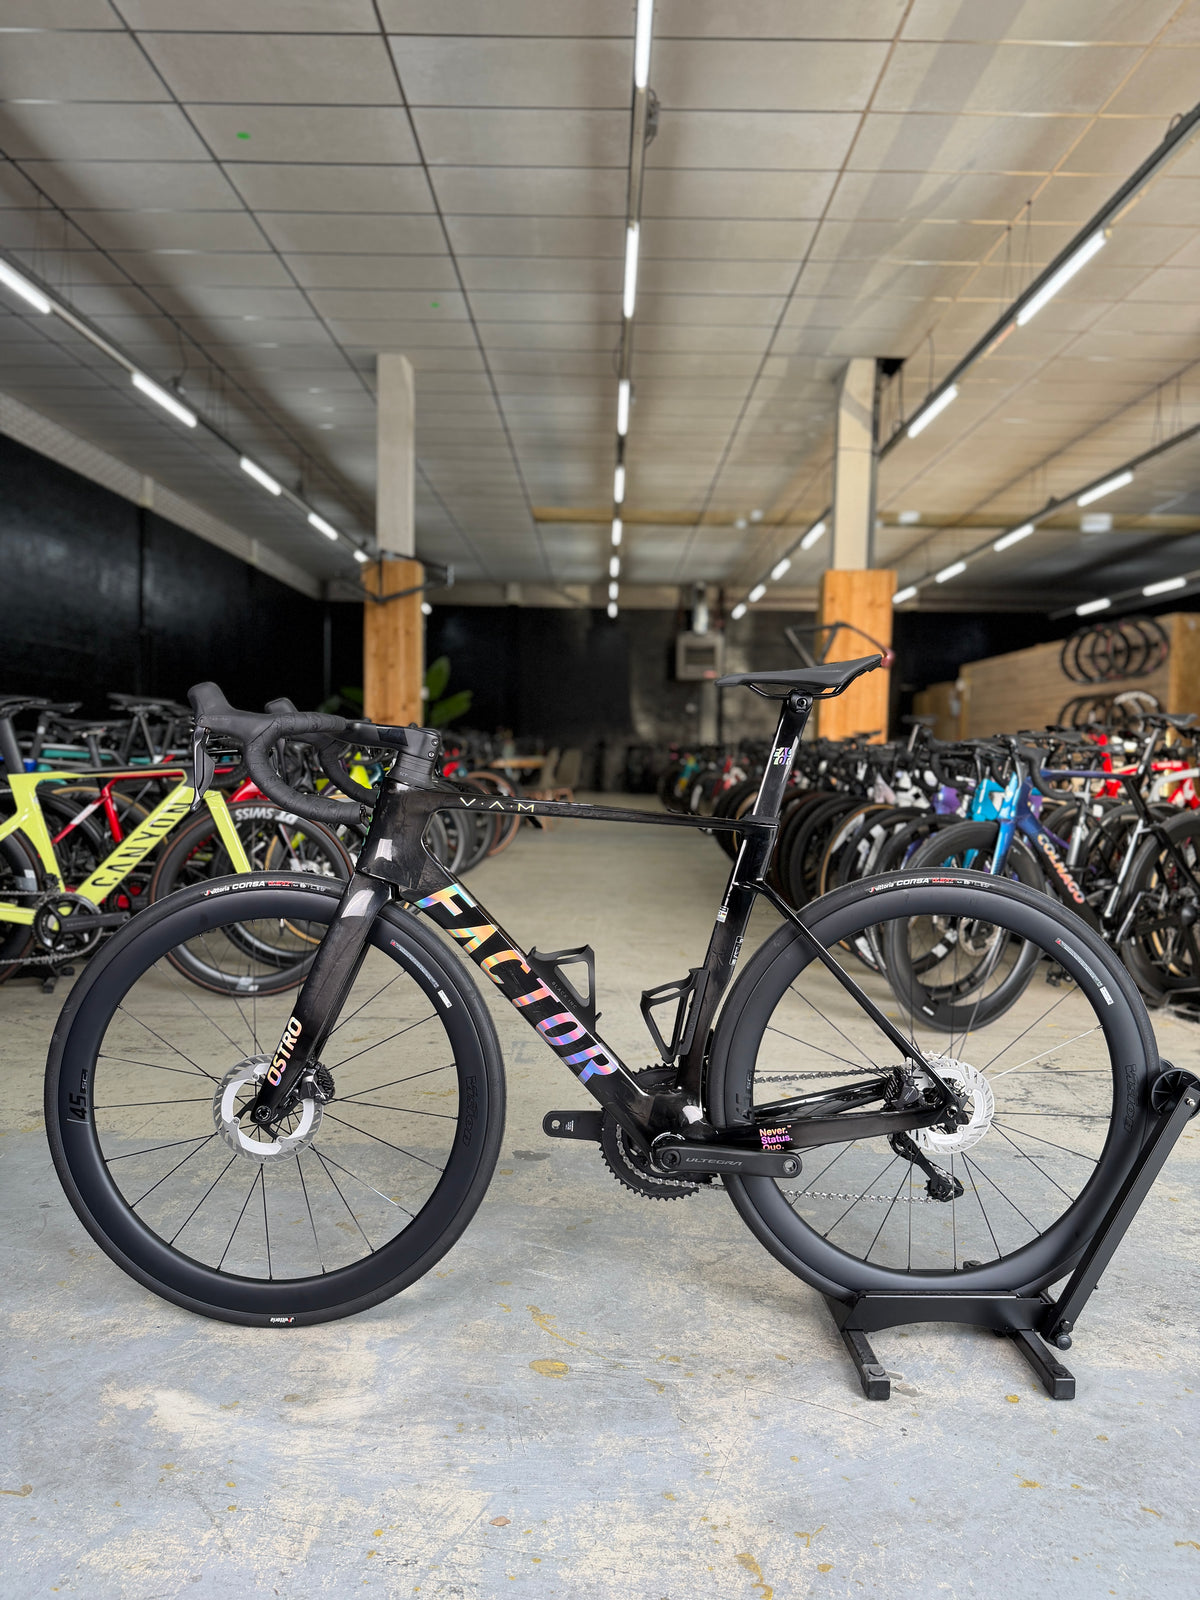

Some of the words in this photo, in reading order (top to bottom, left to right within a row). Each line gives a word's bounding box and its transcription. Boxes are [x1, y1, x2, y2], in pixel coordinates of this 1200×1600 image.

[235, 807, 275, 821] SWISS
[90, 802, 192, 887] CANYON
[232, 881, 265, 890] CORSA
[896, 878, 929, 886] CORSA
[415, 883, 619, 1085] FACTOR
[267, 1016, 303, 1087] OSTRO
[69, 1092, 87, 1120] 45
[761, 1134, 793, 1144] Status.
[686, 1157, 743, 1166] ULTEGRA
